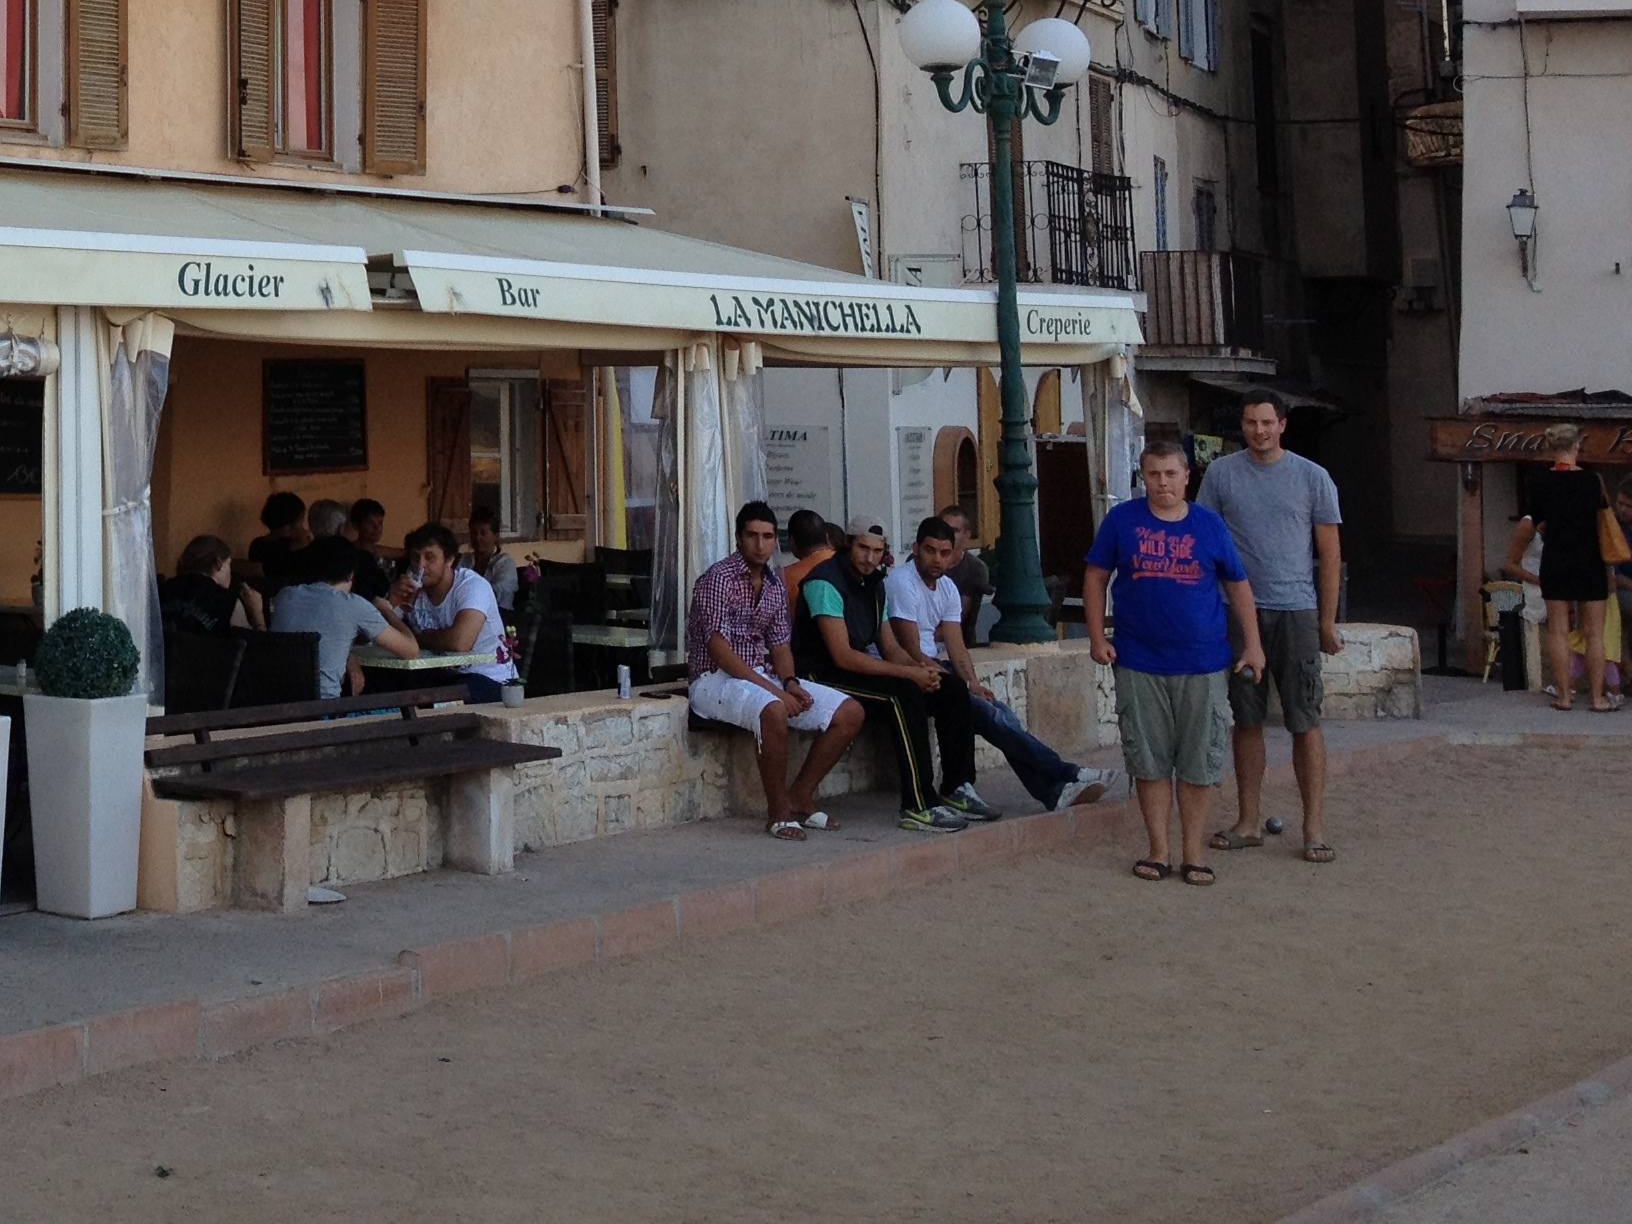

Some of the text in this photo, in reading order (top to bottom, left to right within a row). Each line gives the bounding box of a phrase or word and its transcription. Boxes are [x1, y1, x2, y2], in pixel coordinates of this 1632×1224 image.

[177, 262, 285, 298] Glacier
[496, 277, 541, 309] Bar
[709, 293, 922, 335] LA MANICHELLA
[1026, 309, 1092, 342] Creperie
[1139, 540, 1193, 560] WILD SIDE
